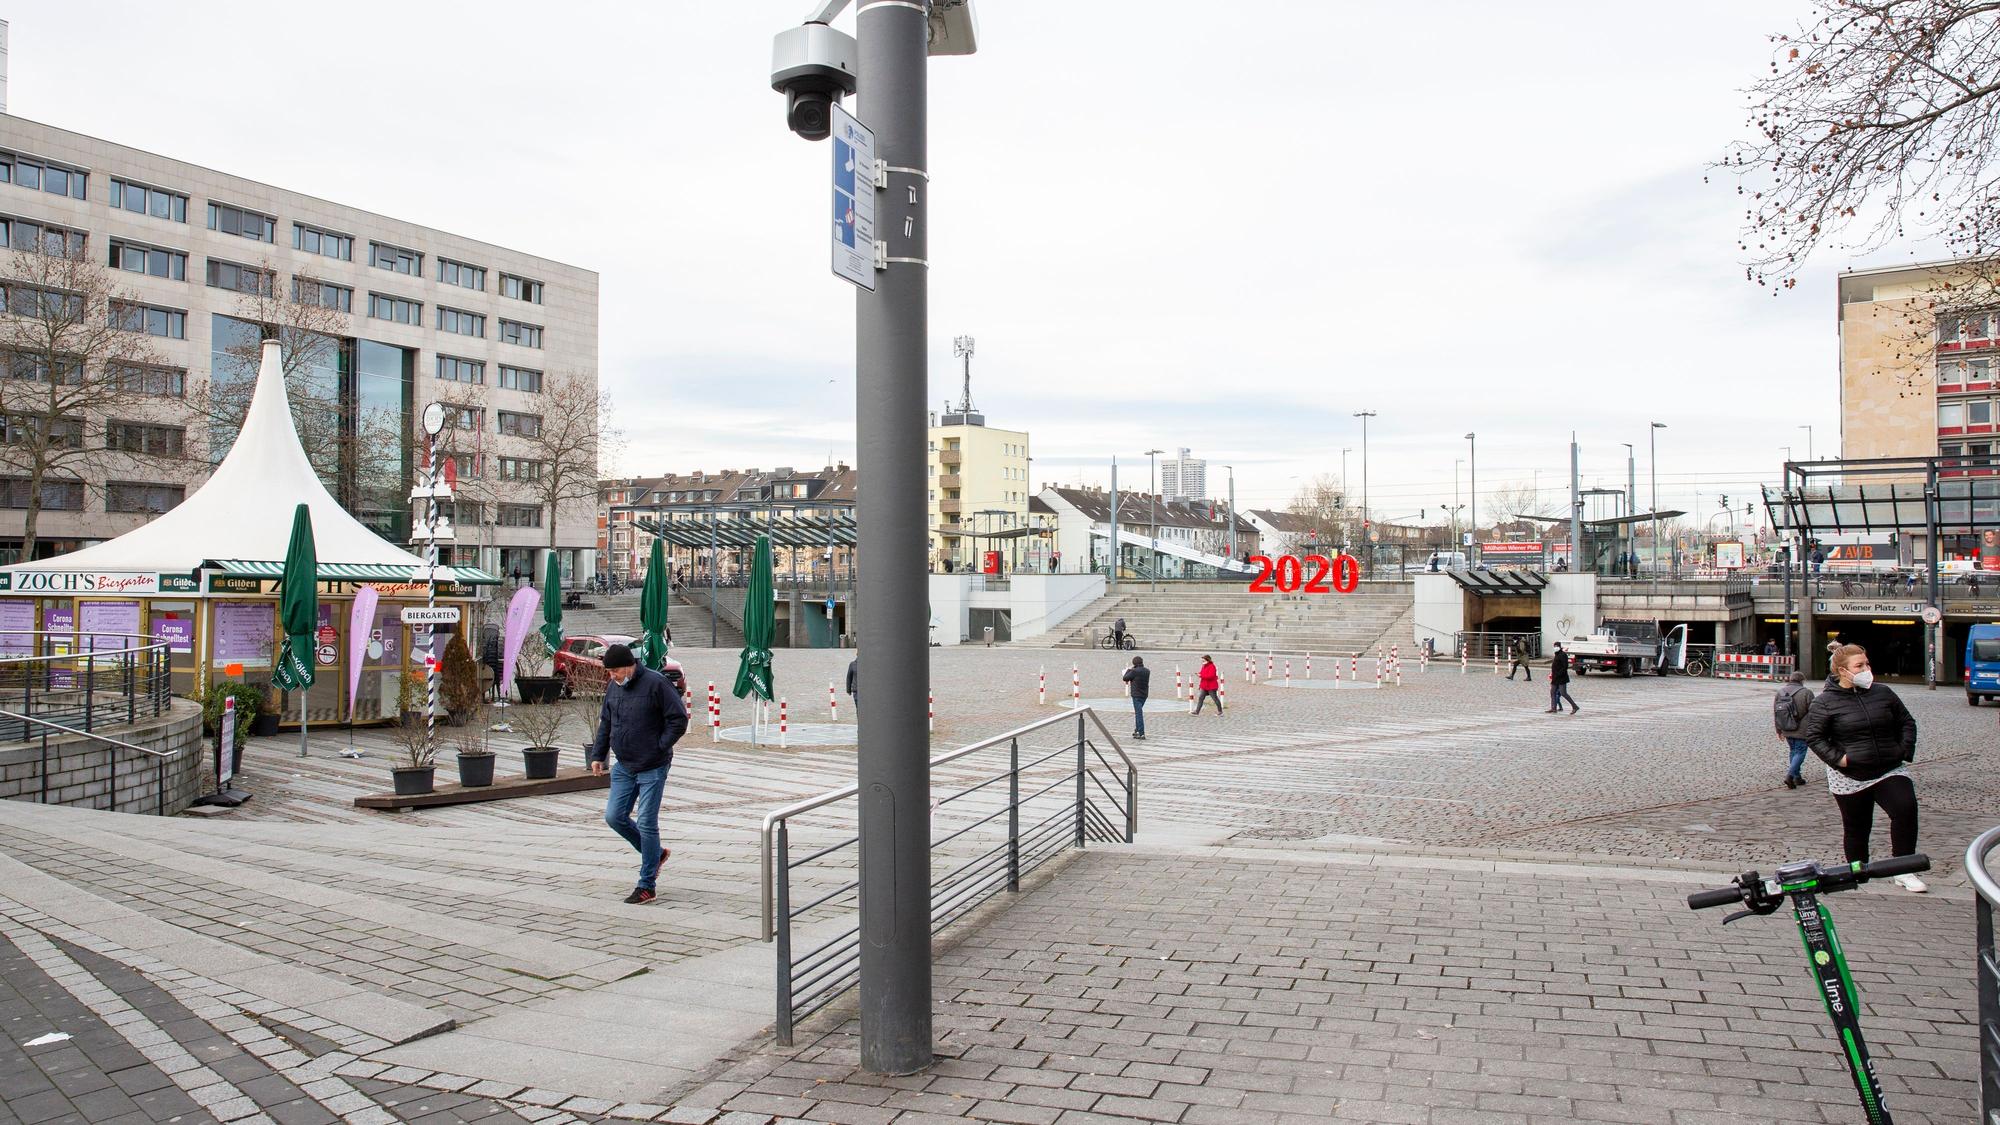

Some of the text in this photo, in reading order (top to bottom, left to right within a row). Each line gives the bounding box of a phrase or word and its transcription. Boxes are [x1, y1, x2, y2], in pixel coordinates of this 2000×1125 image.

[1845, 546, 1873, 558] AWB
[1249, 554, 1359, 593] 2020
[97, 575, 154, 592] Biergarten
[227, 579, 256, 587] Gilden
[1841, 603, 1871, 611] Wiener
[1875, 603, 1896, 611] Platz
[53, 614, 72, 623] Corona
[162, 624, 183, 633] Corona
[1824, 978, 1844, 1013] Lime
